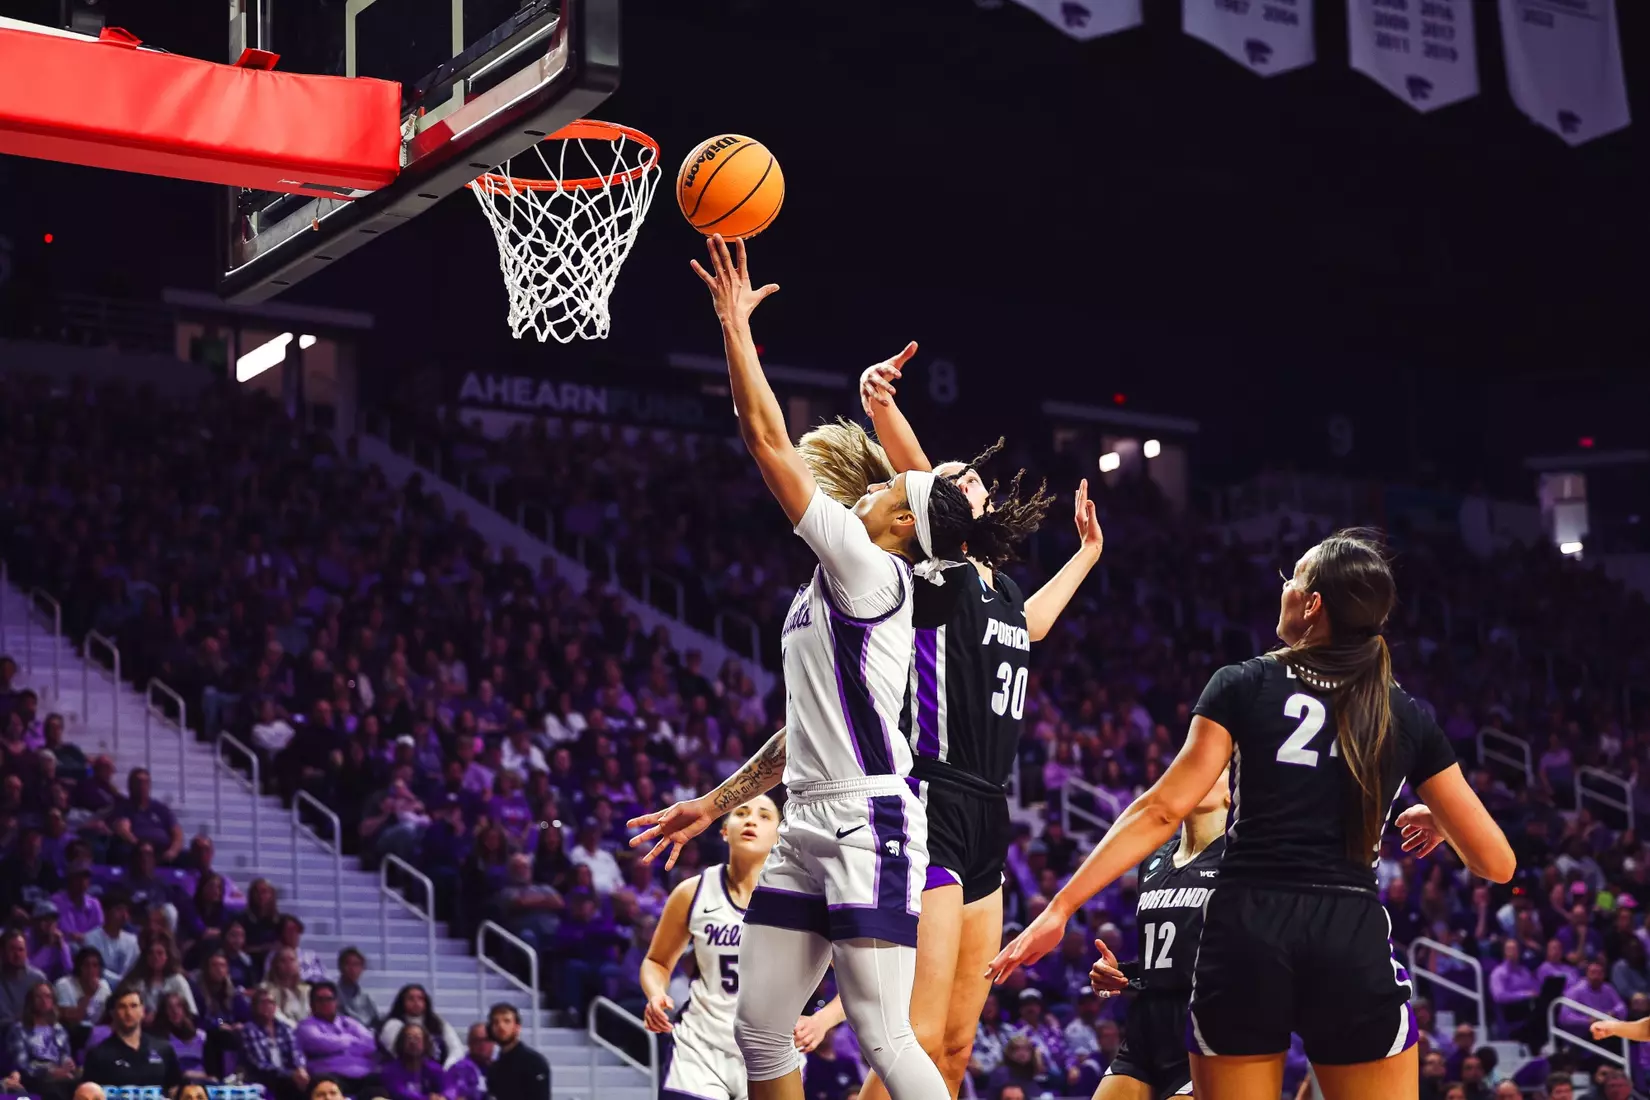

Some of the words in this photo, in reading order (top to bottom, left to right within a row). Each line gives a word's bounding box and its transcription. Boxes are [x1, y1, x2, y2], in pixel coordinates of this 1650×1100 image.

[684, 136, 741, 189] Wilson
[459, 371, 607, 415] AHEARN
[929, 359, 958, 402] 8
[1328, 413, 1355, 456] 9
[991, 661, 1029, 720] 30
[1276, 693, 1338, 767] 2
[1138, 887, 1209, 912] PORTLAND
[1144, 921, 1177, 970] 12
